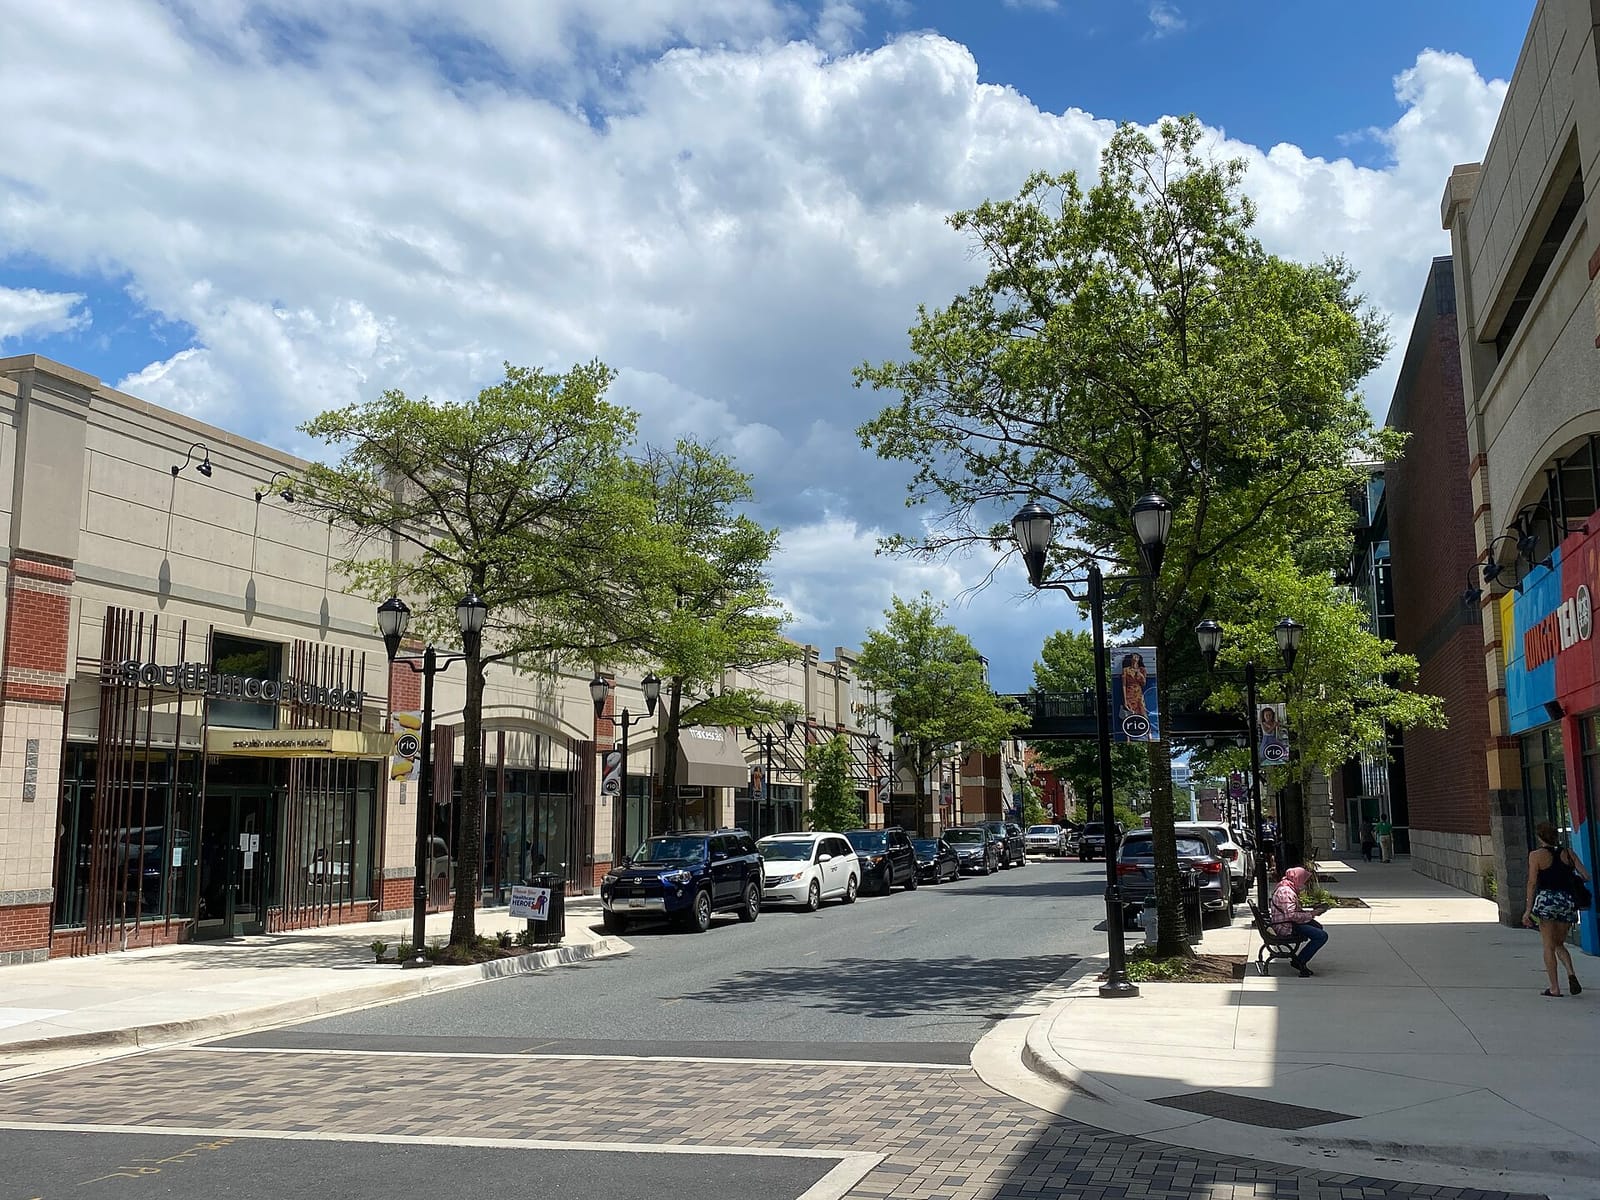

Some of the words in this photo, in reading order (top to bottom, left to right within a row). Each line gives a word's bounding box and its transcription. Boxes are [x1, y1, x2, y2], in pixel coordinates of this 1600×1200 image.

[122, 659, 211, 693] south
[216, 673, 294, 702] moon
[300, 682, 367, 712] under
[1126, 720, 1147, 730] rio
[400, 740, 416, 750] rio
[512, 899, 536, 907] HEROES
